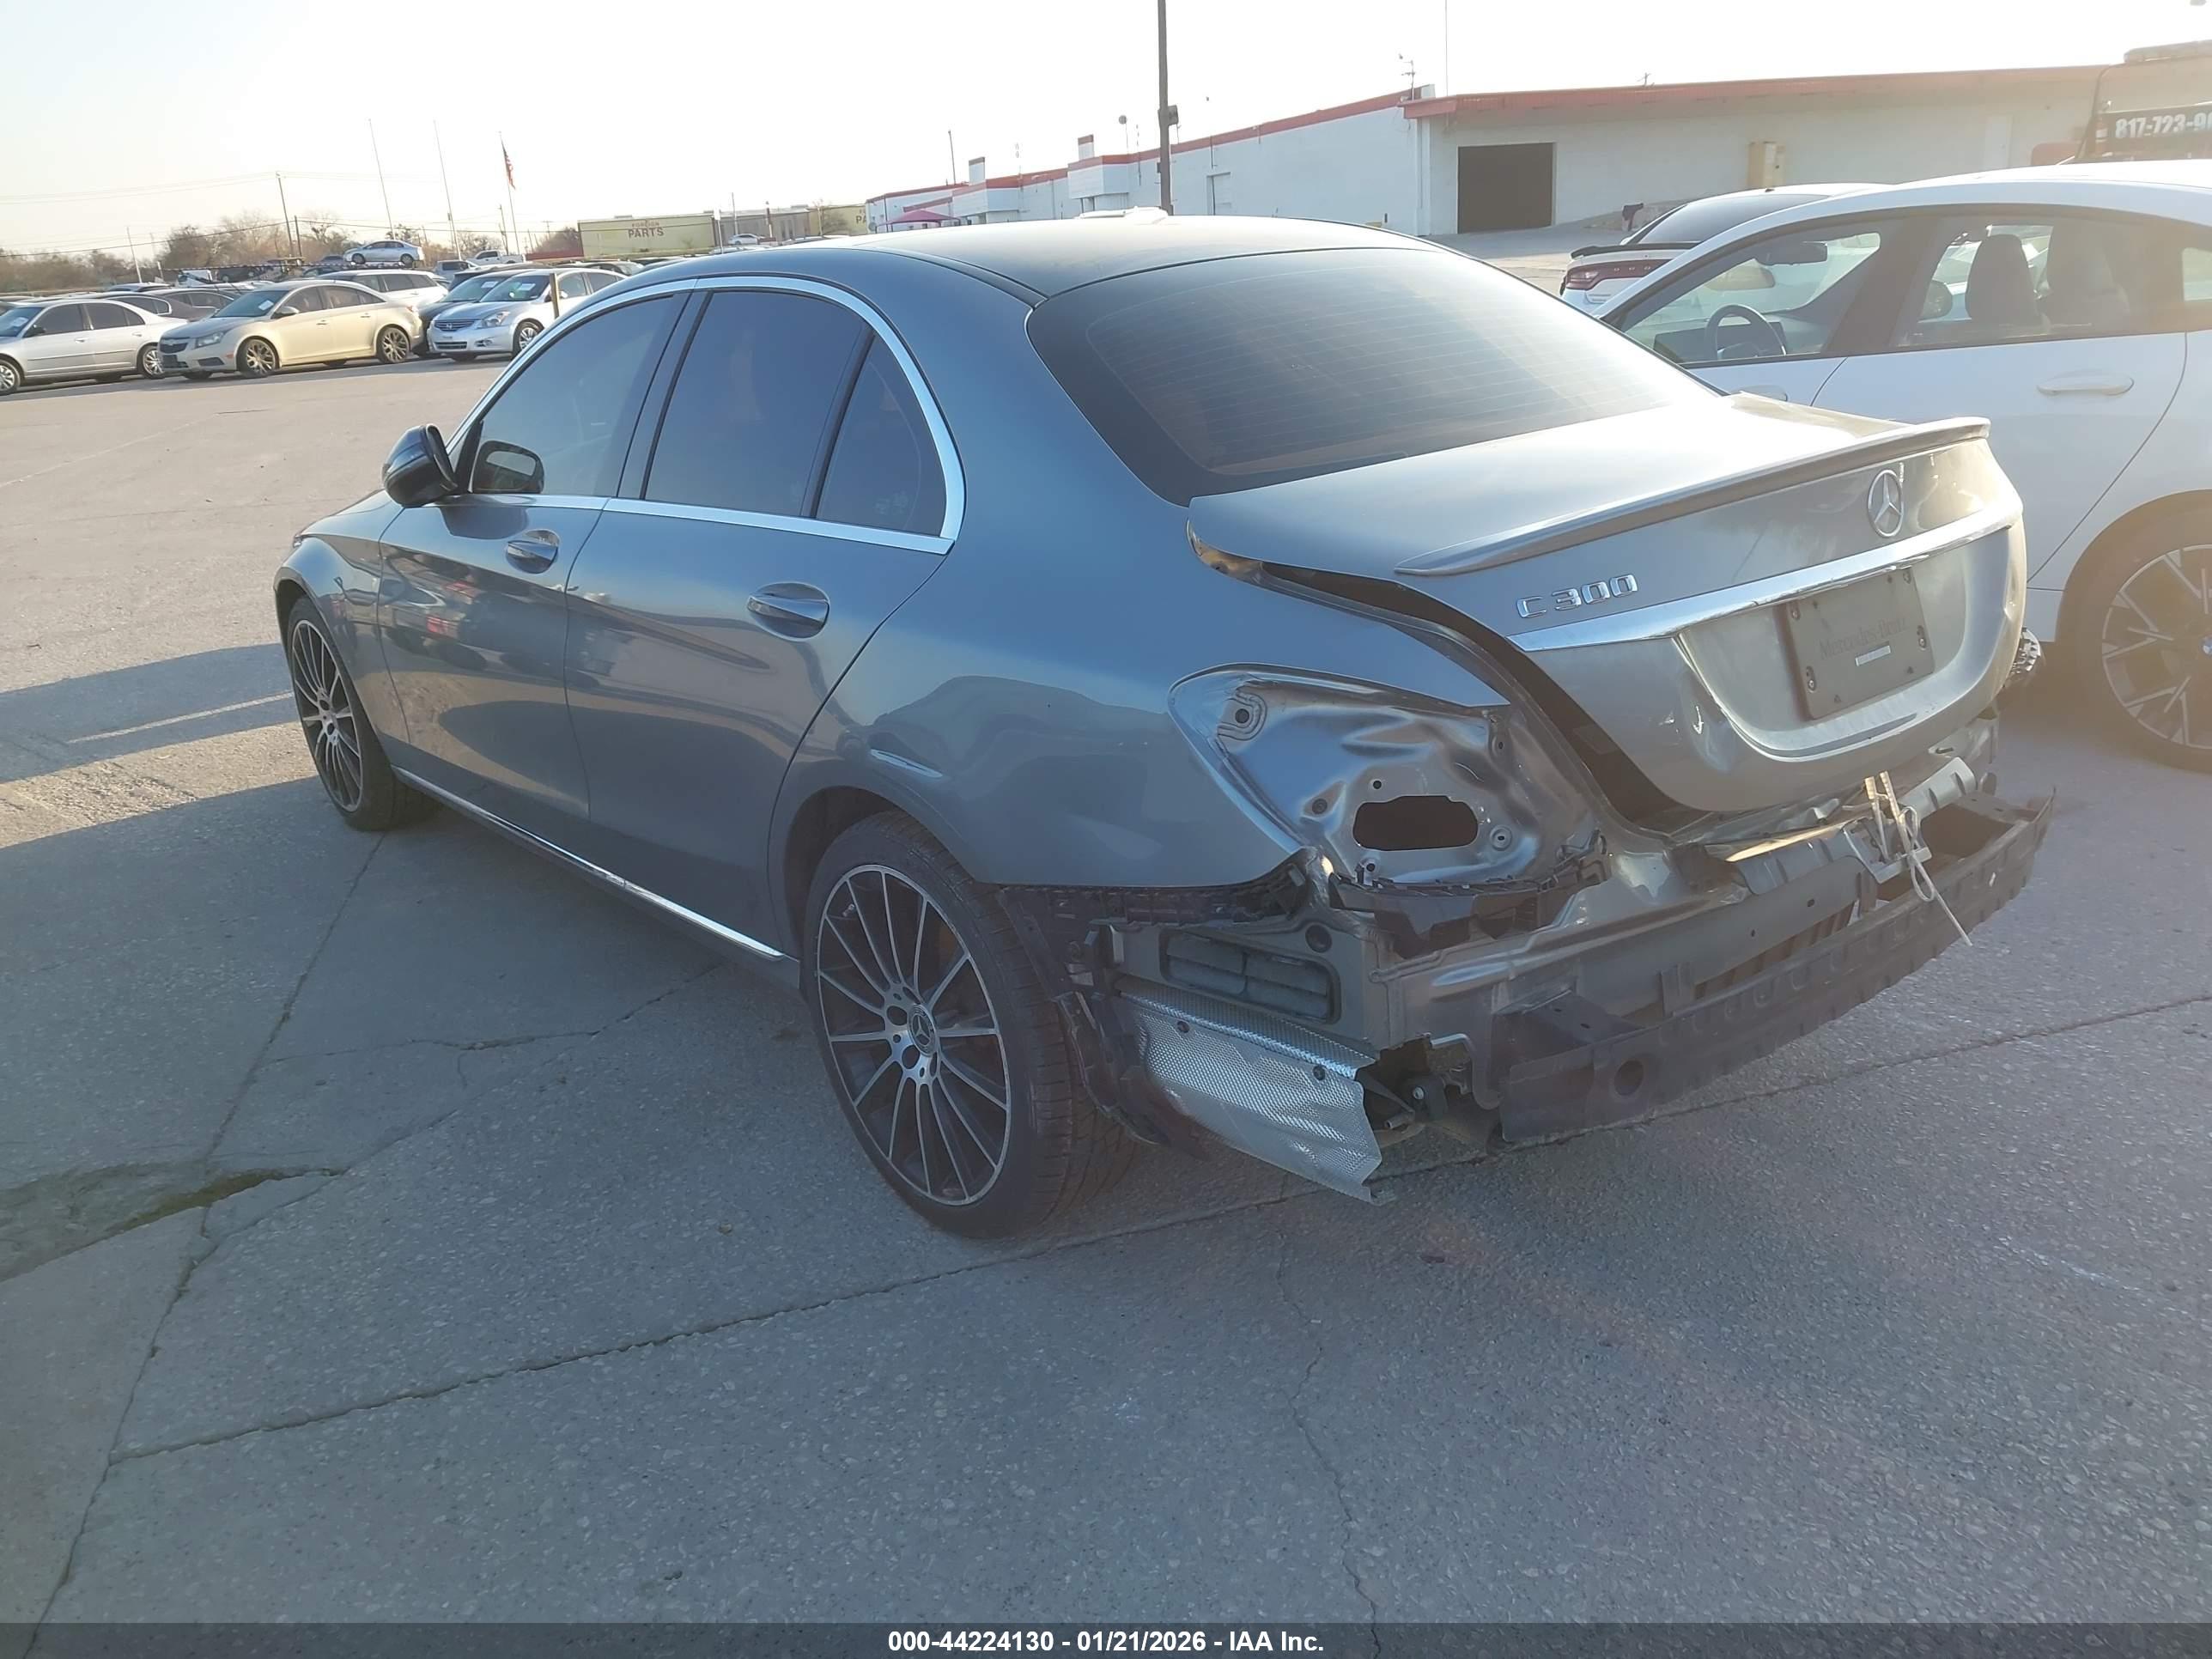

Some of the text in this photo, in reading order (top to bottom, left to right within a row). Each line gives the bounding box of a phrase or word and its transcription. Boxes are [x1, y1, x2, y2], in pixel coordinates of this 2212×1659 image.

[628, 227, 665, 238] PARTS
[1516, 574, 1638, 618] C 300
